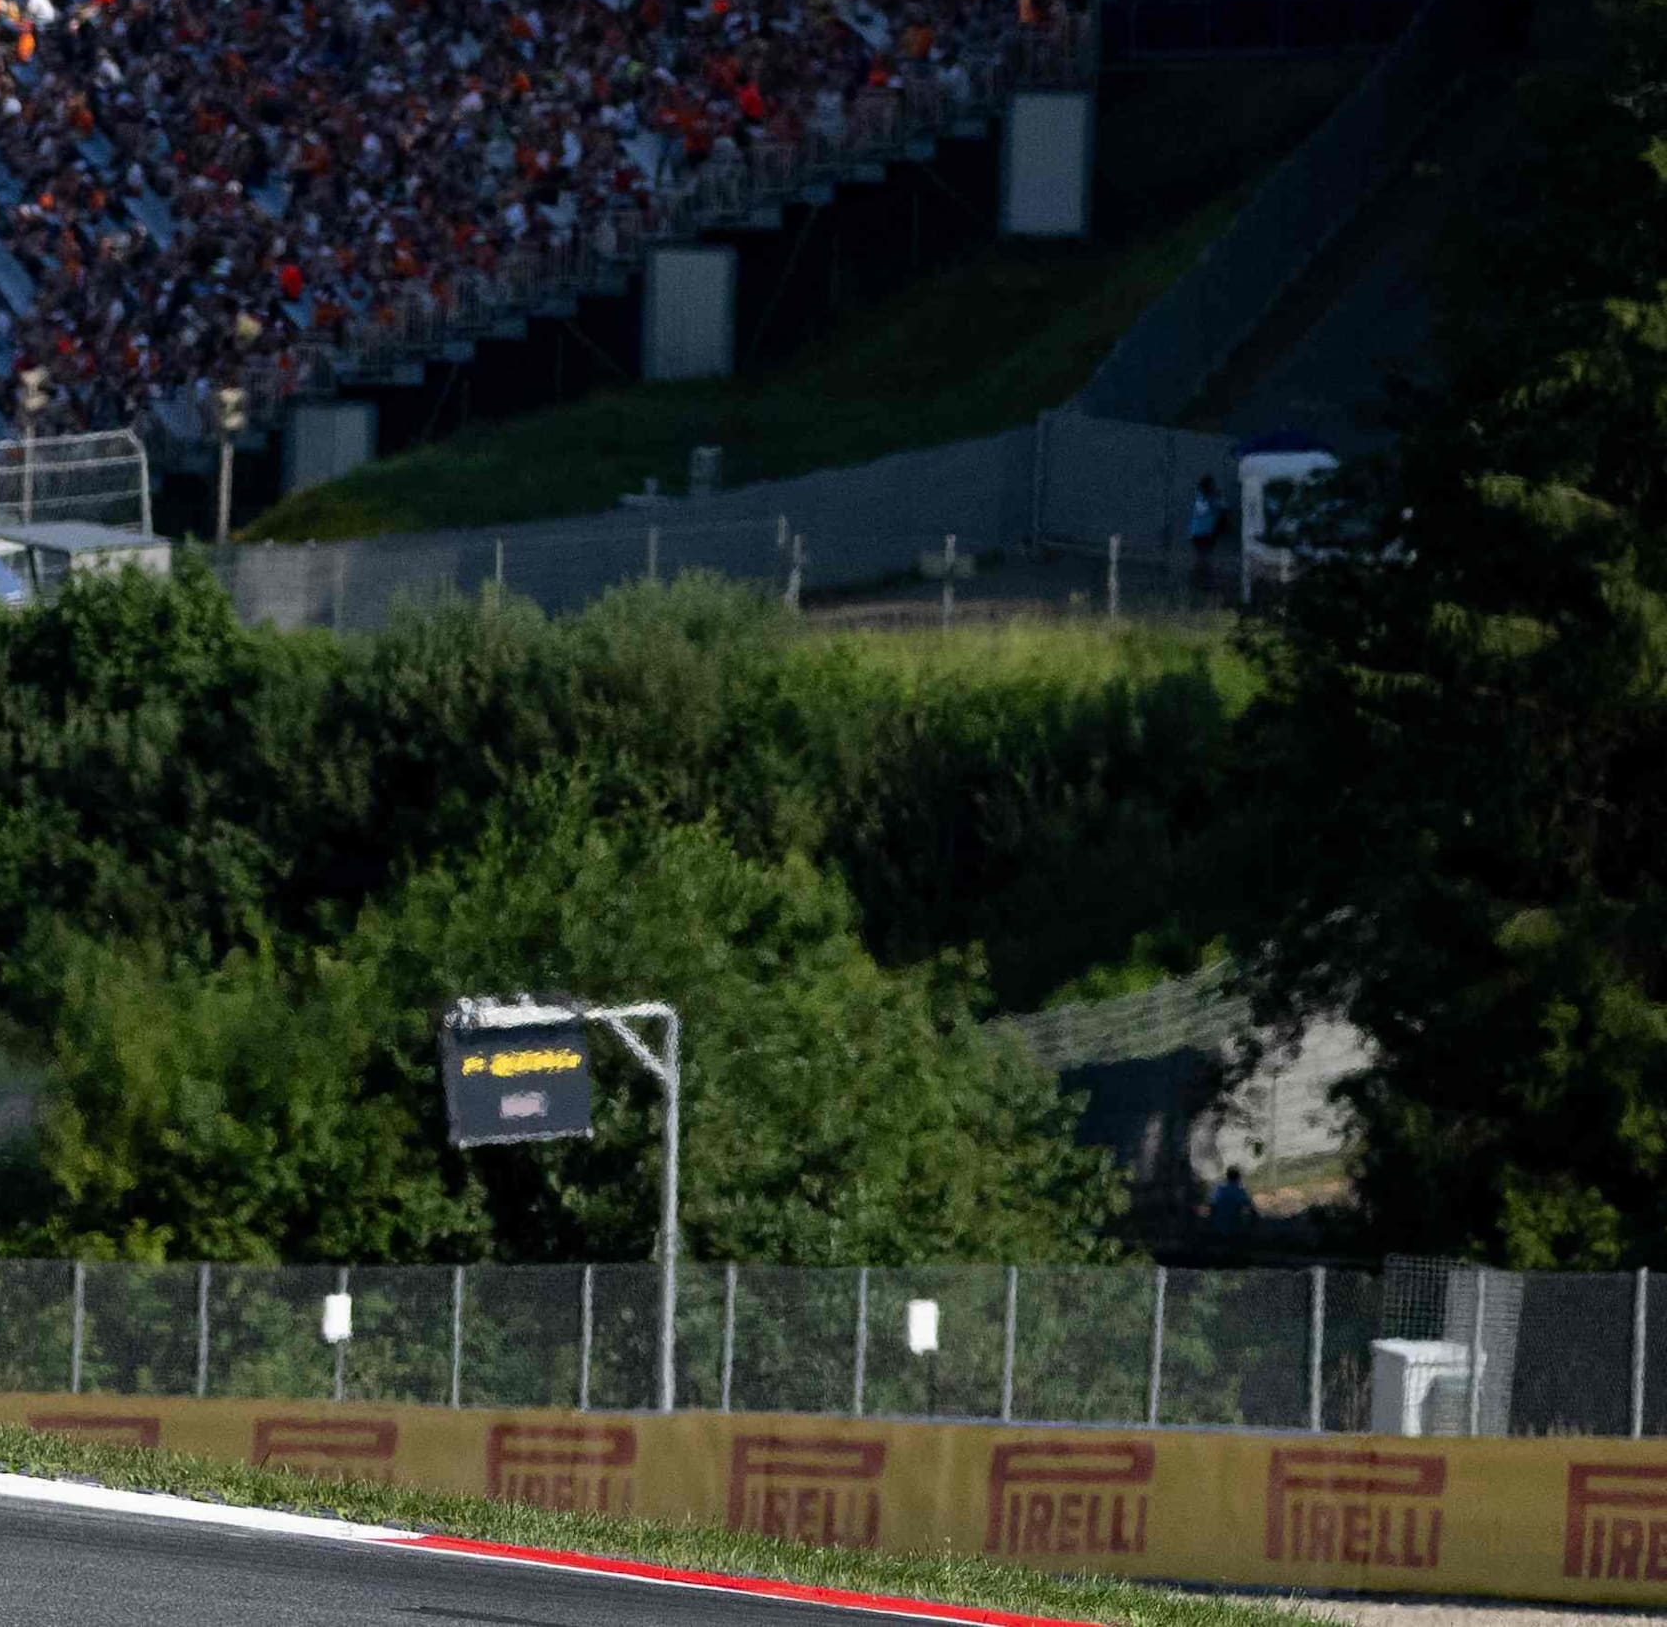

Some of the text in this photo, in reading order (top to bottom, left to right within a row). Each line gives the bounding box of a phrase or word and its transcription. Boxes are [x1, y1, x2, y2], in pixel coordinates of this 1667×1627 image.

[988, 1440, 1155, 1555] PIRELLI
[1268, 1446, 1448, 1568] PIRELLI
[1565, 1464, 1667, 1581] PIRE
